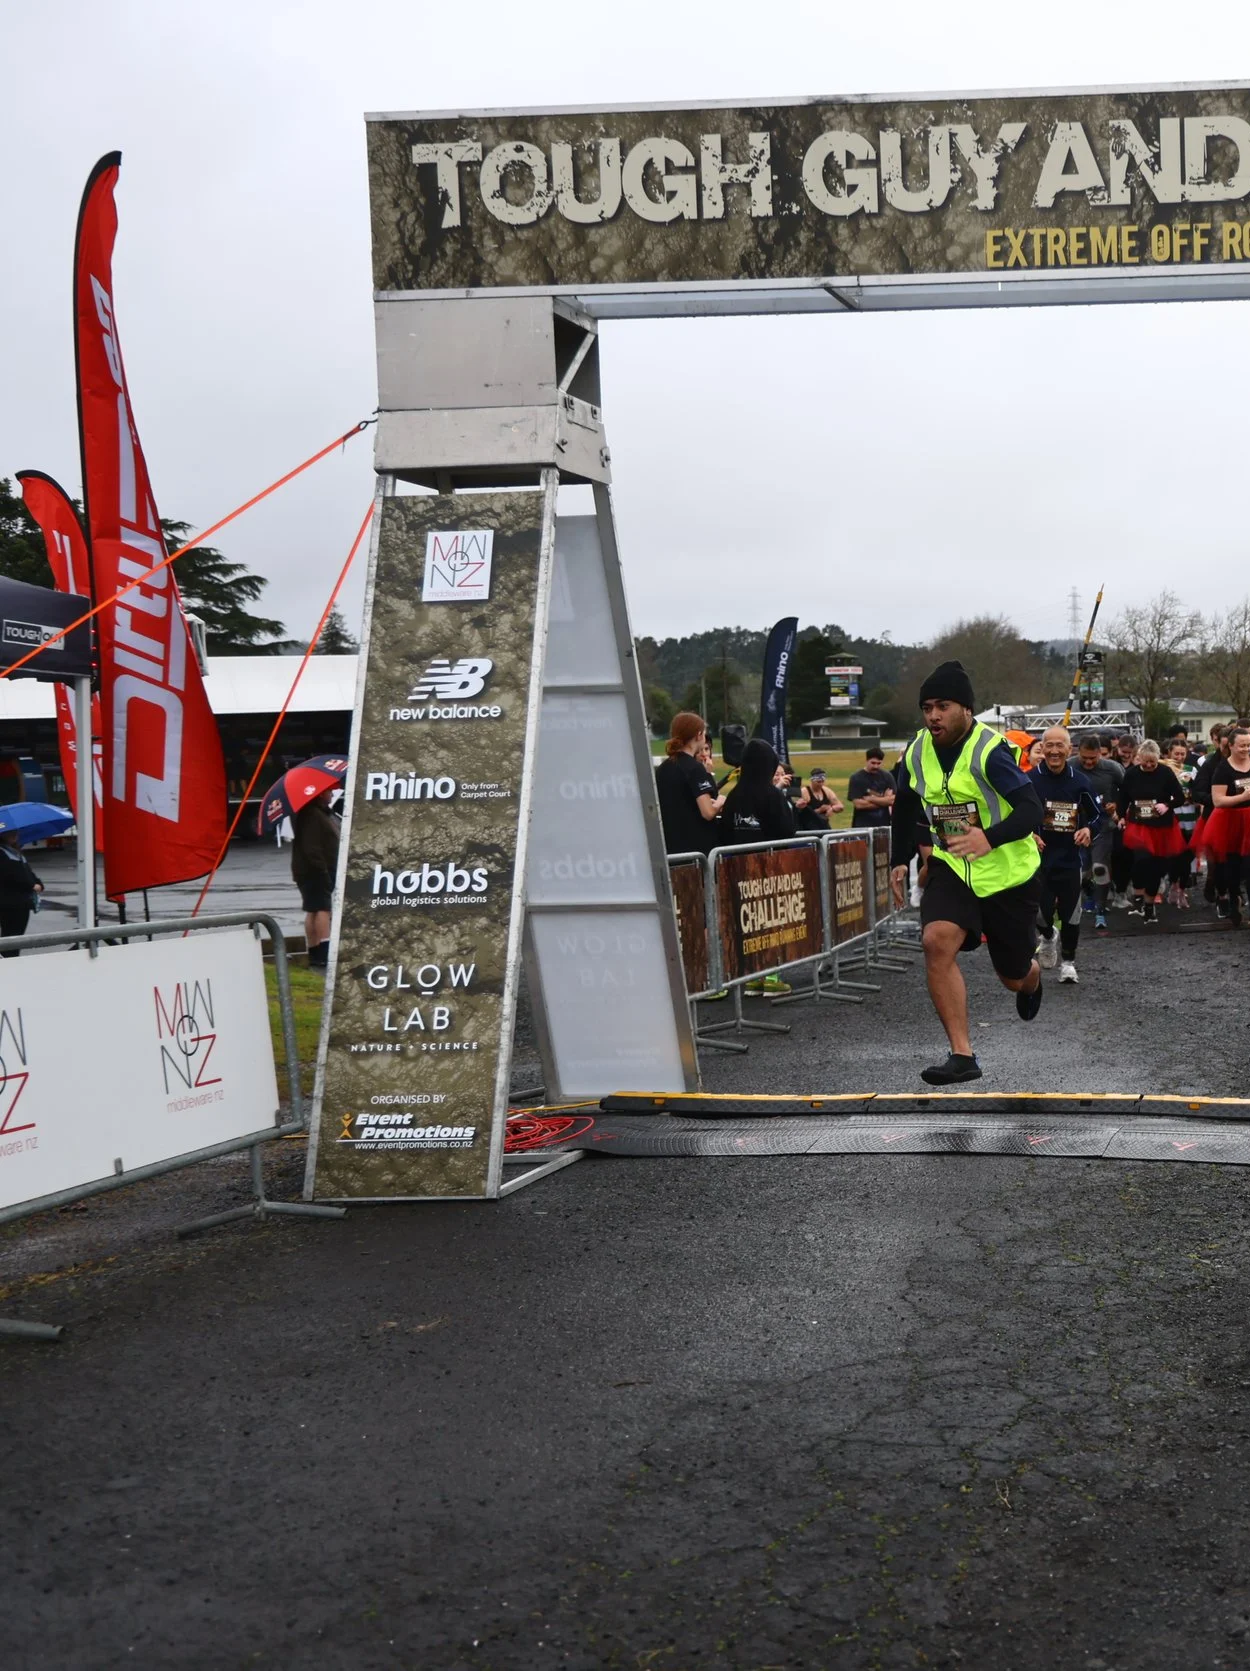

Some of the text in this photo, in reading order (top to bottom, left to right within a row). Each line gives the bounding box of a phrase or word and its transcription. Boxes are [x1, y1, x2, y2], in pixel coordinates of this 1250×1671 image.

[412, 130, 778, 229] TOUGH
[802, 121, 1028, 217] GUY
[985, 224, 1139, 268] EXTREME
[1150, 222, 1211, 262] OFF
[6, 626, 41, 641] TOUGH
[775, 651, 789, 689] Rhino
[389, 704, 502, 721] new balance
[365, 771, 456, 801] Rhino
[460, 789, 511, 800] Carpet Court
[461, 781, 499, 792] Only from
[372, 862, 489, 896] hobbs
[738, 879, 763, 900] TOUGH
[763, 876, 777, 895] GUY
[791, 872, 804, 890] GAL
[371, 894, 488, 909] global logistics solutions
[741, 890, 806, 933] CHALLENGE
[366, 963, 475, 994] GLOW
[384, 1006, 450, 1031] LAB
[350, 1043, 402, 1053] NATURE
[421, 1041, 479, 1051] SCIENCE
[370, 1094, 446, 1105] ORGANISED BY
[355, 1112, 414, 1127] Event
[360, 1124, 476, 1140] Promotions
[354, 1138, 474, 1151] www.eventpromotions.co.nz
